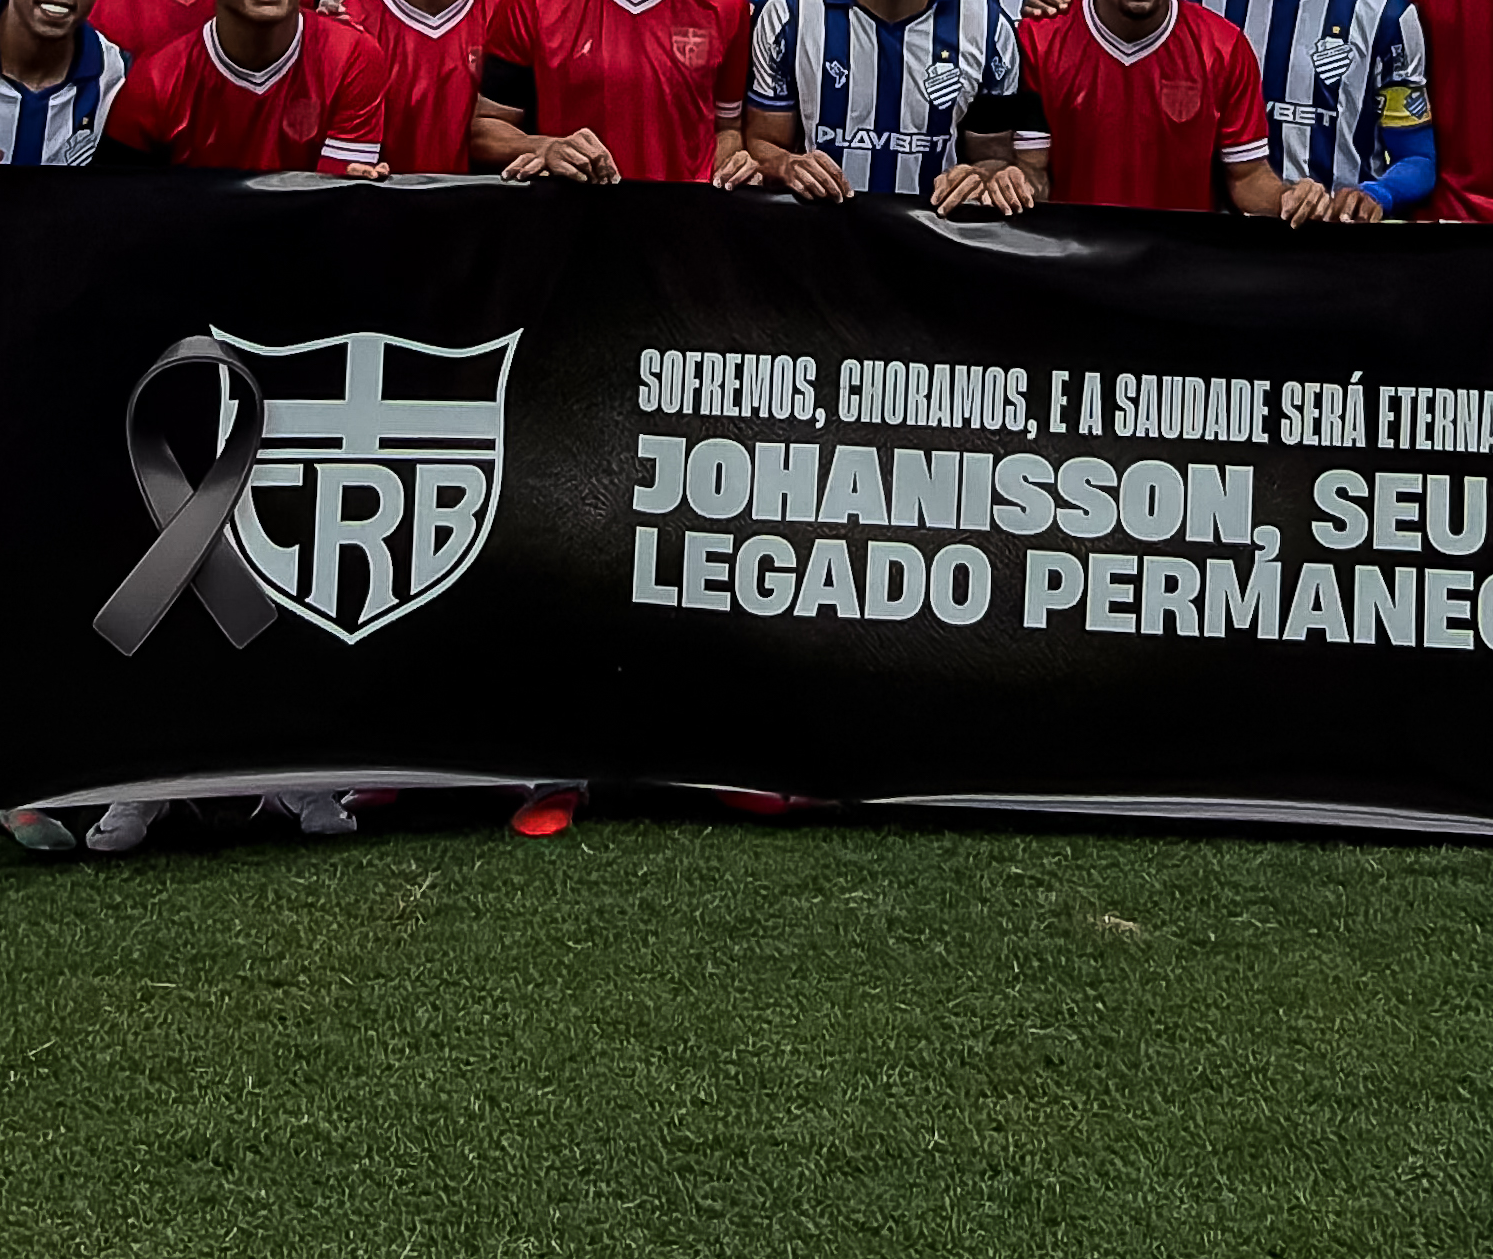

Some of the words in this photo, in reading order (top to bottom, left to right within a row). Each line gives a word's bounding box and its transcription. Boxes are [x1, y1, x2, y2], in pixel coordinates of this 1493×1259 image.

[817, 126, 950, 153] PLAYBET
[1266, 100, 1337, 127] BET
[638, 348, 827, 430] SOFREMOS,
[838, 358, 1038, 441] CHORAMOS,
[1049, 370, 1070, 434] E
[1078, 371, 1103, 436] A
[1114, 372, 1271, 445] SAUDADE
[1280, 370, 1366, 448] SERÁ
[233, 462, 488, 625] CRB
[632, 433, 1282, 559] JOHANISSON,
[1311, 469, 1488, 556] SEU
[631, 525, 992, 626] LEGADO
